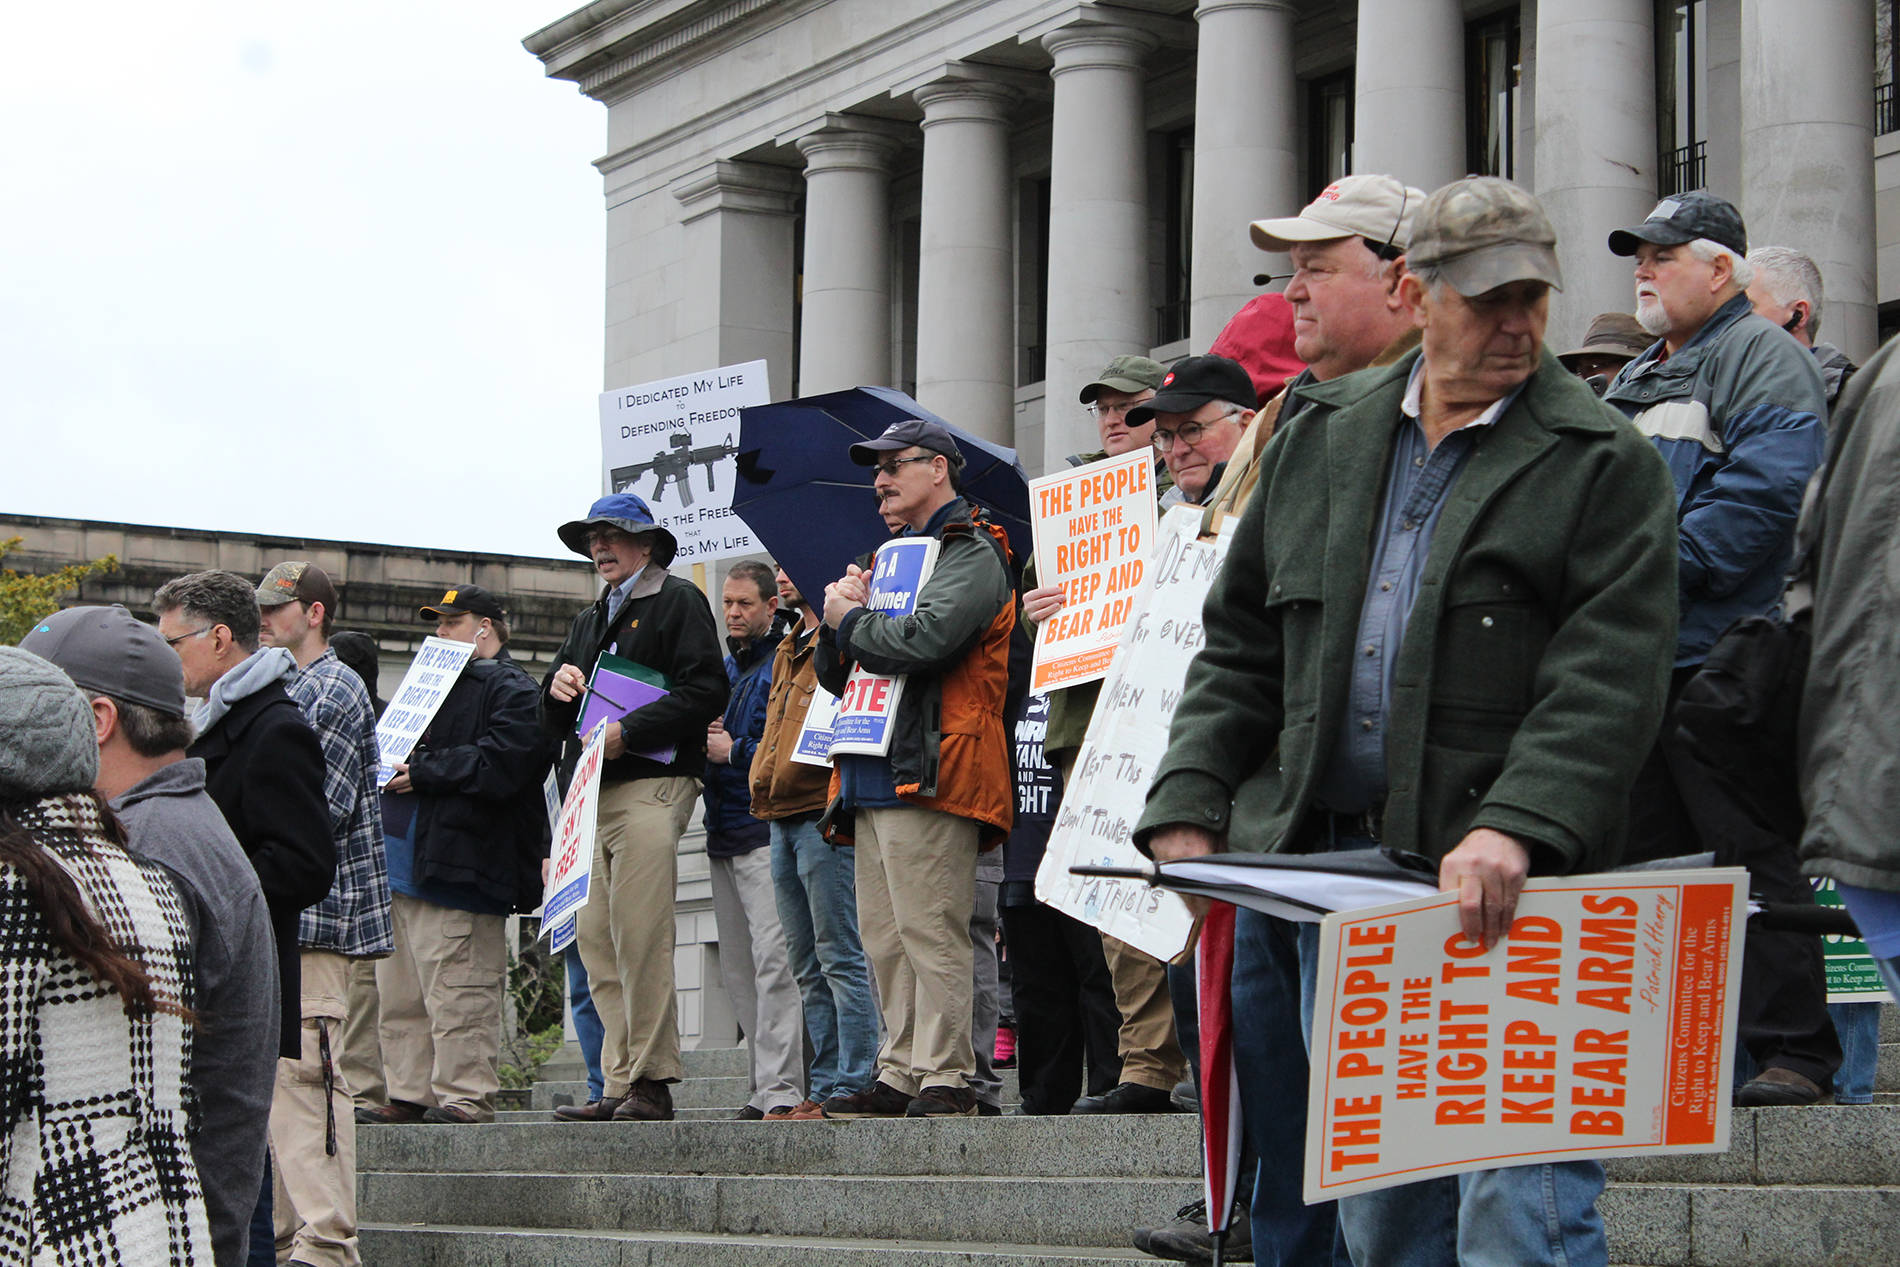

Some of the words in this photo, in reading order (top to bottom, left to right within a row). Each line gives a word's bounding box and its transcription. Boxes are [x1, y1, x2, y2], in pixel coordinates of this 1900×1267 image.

[626, 386, 689, 408] DEDICATED
[694, 380, 713, 394] MY
[718, 375, 743, 389] LIFE
[621, 418, 685, 439] DEFENDING
[1040, 483, 1073, 519] THE
[1080, 462, 1147, 508] PEOPLE
[673, 513, 694, 526] THE
[685, 530, 702, 538] THAT
[1069, 513, 1099, 538] HAVE
[1103, 506, 1123, 529] THE
[699, 540, 719, 554] MY
[724, 536, 750, 549] LIFE
[1057, 533, 1112, 575] RIGHT
[1118, 524, 1140, 558] TO
[886, 552, 899, 577] A
[1105, 559, 1144, 596] AND
[870, 587, 911, 611] Owner
[1044, 609, 1094, 646] BEAR
[417, 645, 438, 667] THE
[433, 648, 470, 672] PEOPLE
[418, 671, 432, 685] HAVE
[431, 673, 445, 687] THE
[398, 686, 430, 706] RIGHT
[421, 690, 441, 709] TO
[384, 709, 411, 730] KEEP
[403, 714, 428, 733] AND
[386, 735, 416, 757] ARMS
[1018, 771, 1034, 782] AND
[1643, 893, 1674, 944] Henry
[1683, 927, 1698, 947] the
[1701, 918, 1717, 956] Arms
[1442, 930, 1492, 984] TO
[1505, 916, 1563, 1006] AND
[1576, 894, 1639, 1015] ARMS
[1681, 951, 1696, 971] for
[1698, 959, 1713, 990] Bear
[1843, 974, 1864, 985] Keep
[1336, 925, 1396, 1079] PEOPLE
[1401, 977, 1432, 1024] THE
[1675, 975, 1694, 1049] Committee
[1698, 994, 1710, 1018] and
[1693, 1021, 1712, 1056] Keep
[1397, 1033, 1429, 1100] HAVE
[1435, 1000, 1489, 1125] RIGHT
[1501, 1020, 1557, 1123] KEEP
[1671, 1052, 1688, 1107] Citizens
[1694, 1060, 1706, 1073] to
[1570, 1029, 1630, 1136] BEAR
[1689, 1077, 1707, 1113] Right
[1331, 1095, 1381, 1172] THE
